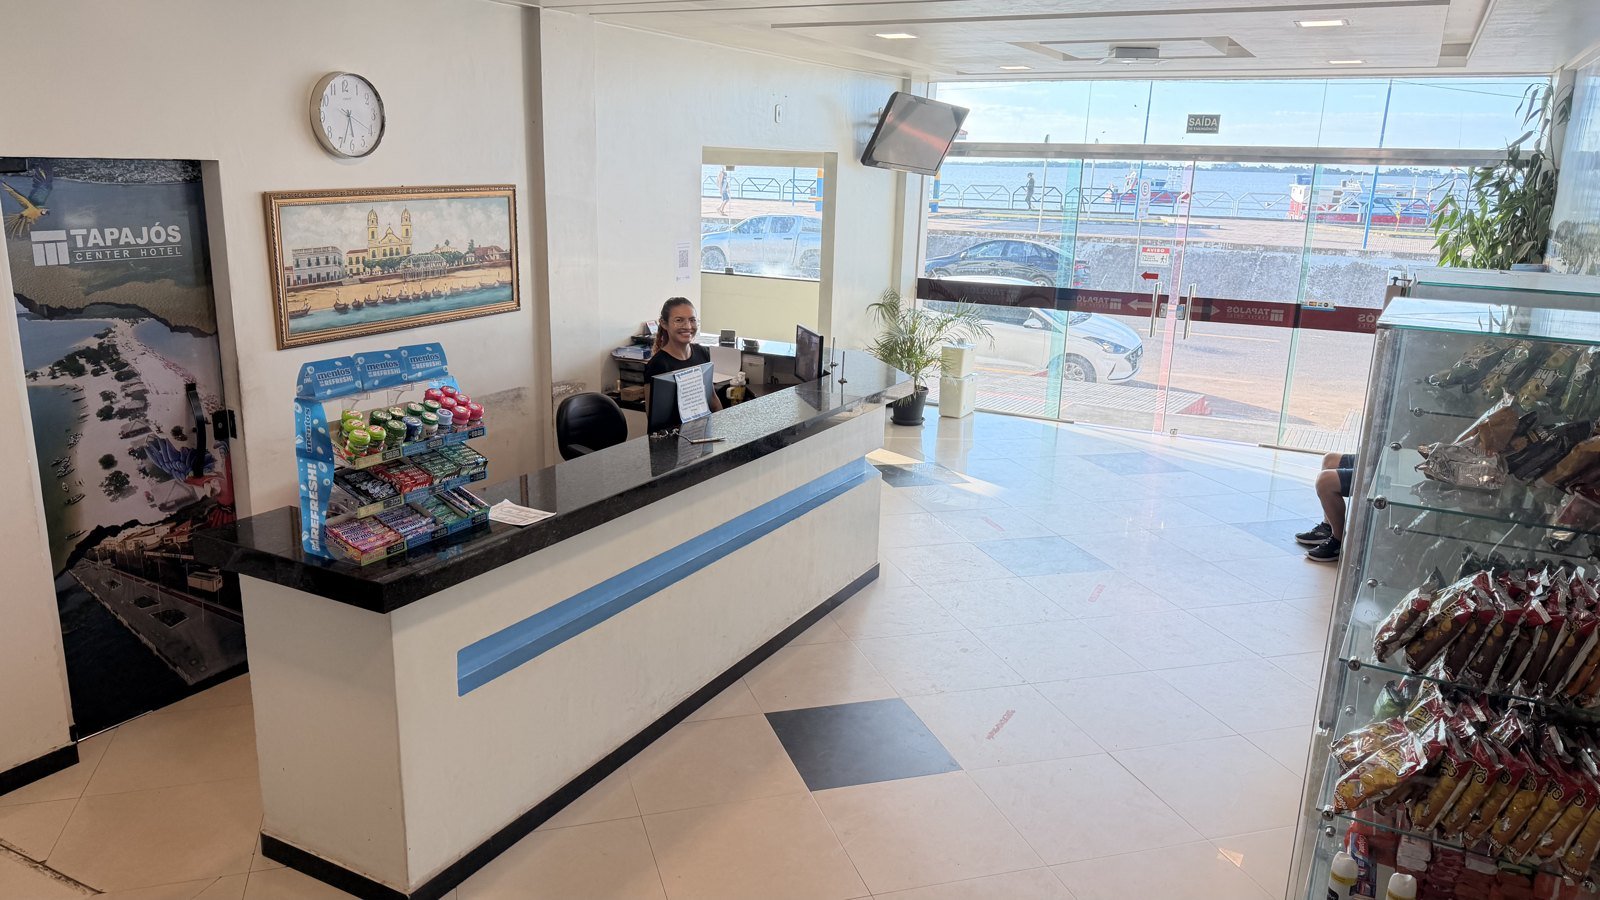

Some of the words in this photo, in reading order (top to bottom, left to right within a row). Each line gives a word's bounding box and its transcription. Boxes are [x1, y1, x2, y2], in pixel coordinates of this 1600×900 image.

[330, 83, 336, 96] 11
[342, 80, 349, 92] 12
[364, 93, 370, 106] 2
[1188, 115, 1218, 127] SAÍDA
[327, 126, 332, 138] 8
[338, 136, 344, 148] 7
[350, 139, 355, 152] 6
[70, 222, 182, 248] TAPAJÓS
[76, 250, 130, 260] CENTER
[140, 246, 182, 257] HOTEL
[410, 353, 440, 362] mentos
[366, 360, 399, 370] mentos
[317, 368, 351, 380] mentos
[324, 376, 354, 386] REFRESH!
[304, 408, 312, 453] mentos
[307, 462, 320, 540] REFRESH!
